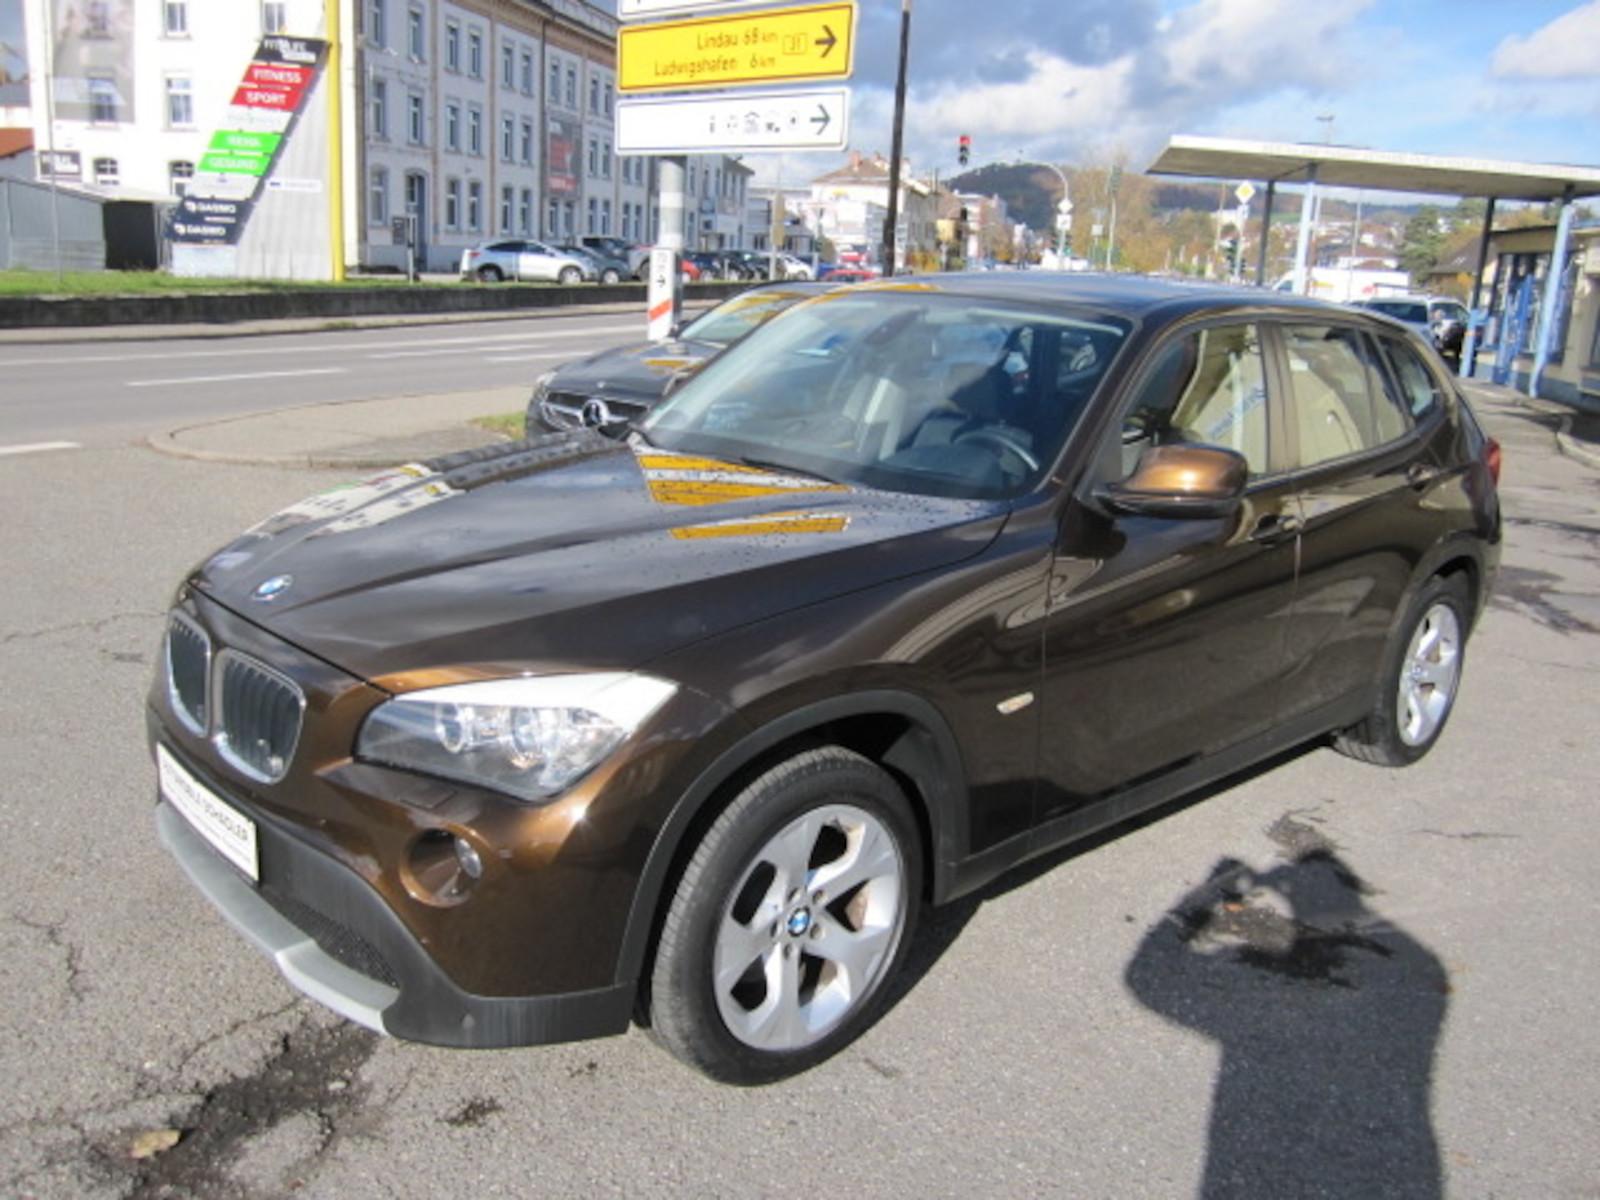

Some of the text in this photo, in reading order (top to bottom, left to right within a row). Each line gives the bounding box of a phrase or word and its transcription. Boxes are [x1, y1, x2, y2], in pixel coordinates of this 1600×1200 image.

[697, 32, 738, 50] Lindau
[654, 57, 737, 78] Ludwigshafen
[750, 53, 758, 69] 6
[253, 68, 302, 83] FITNESS
[245, 91, 287, 105] SPORT
